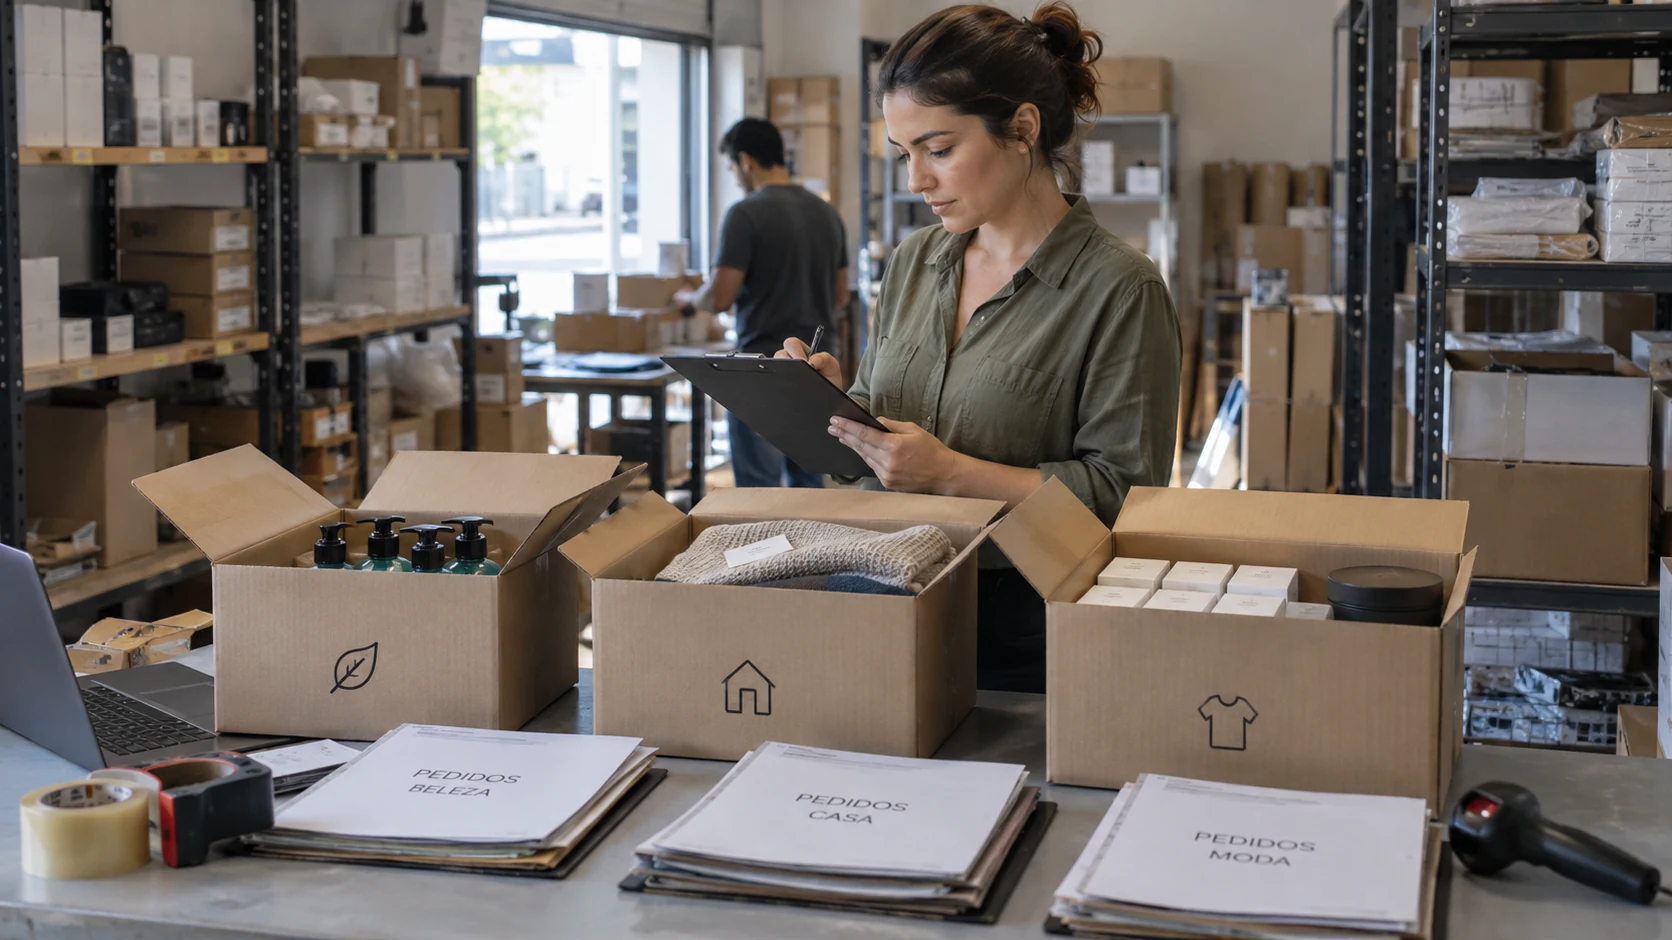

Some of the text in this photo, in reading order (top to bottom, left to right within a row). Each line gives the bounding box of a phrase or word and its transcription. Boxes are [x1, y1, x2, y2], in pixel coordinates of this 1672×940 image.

[413, 769, 521, 784] PEDIDOS
[408, 784, 490, 797] BELEZA
[795, 793, 909, 812] PEDIDOS
[808, 810, 873, 824] CASA
[1194, 831, 1316, 852] PEDIDOS
[1209, 850, 1291, 866] MODA
